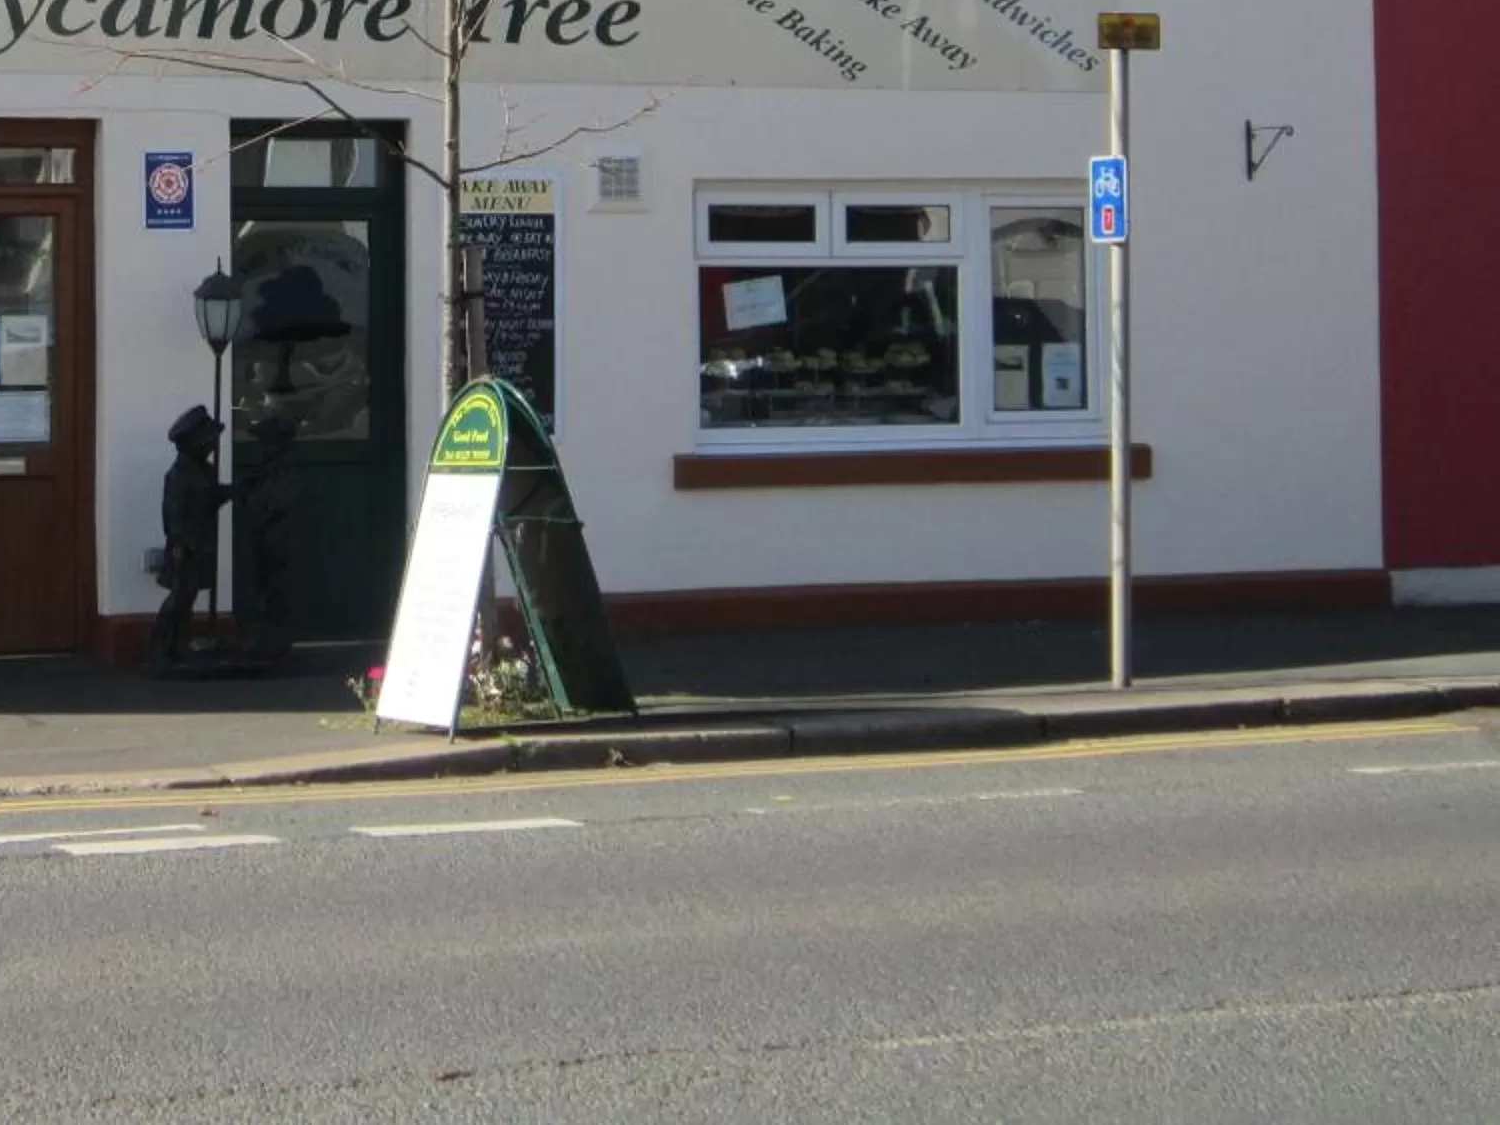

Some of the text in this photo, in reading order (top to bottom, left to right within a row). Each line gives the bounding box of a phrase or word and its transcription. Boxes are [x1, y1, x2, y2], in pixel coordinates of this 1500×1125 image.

[774, 7, 869, 83] Baking
[899, 15, 980, 72] Away
[470, 196, 532, 210] MENU
